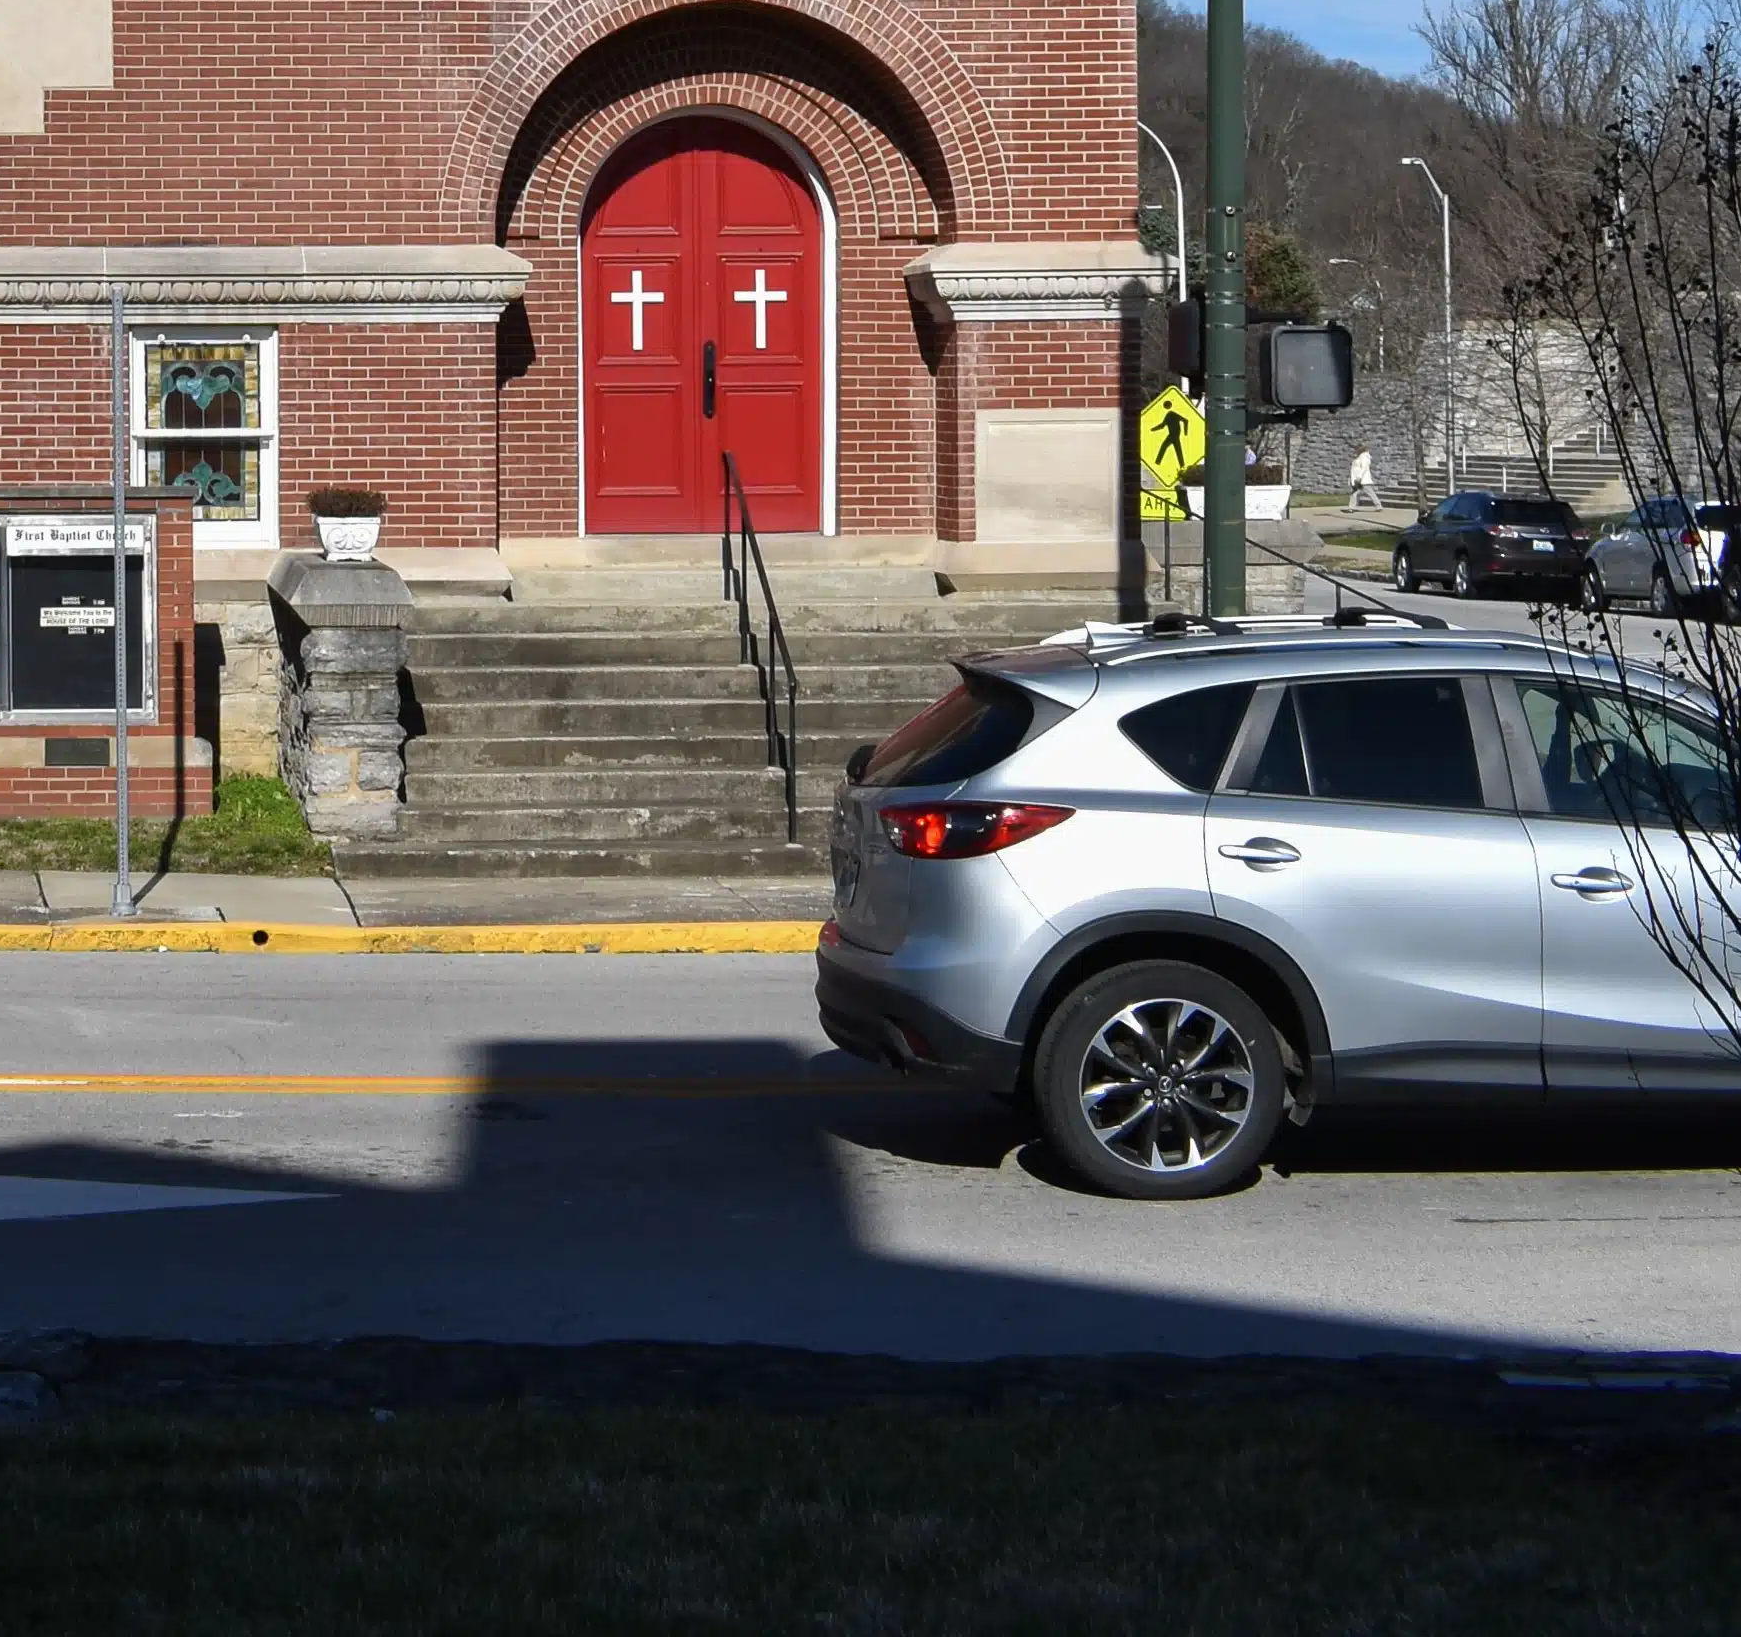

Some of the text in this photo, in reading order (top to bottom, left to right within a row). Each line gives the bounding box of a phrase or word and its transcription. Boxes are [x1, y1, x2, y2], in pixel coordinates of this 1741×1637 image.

[14, 529, 136, 542] First Baptist Chch
